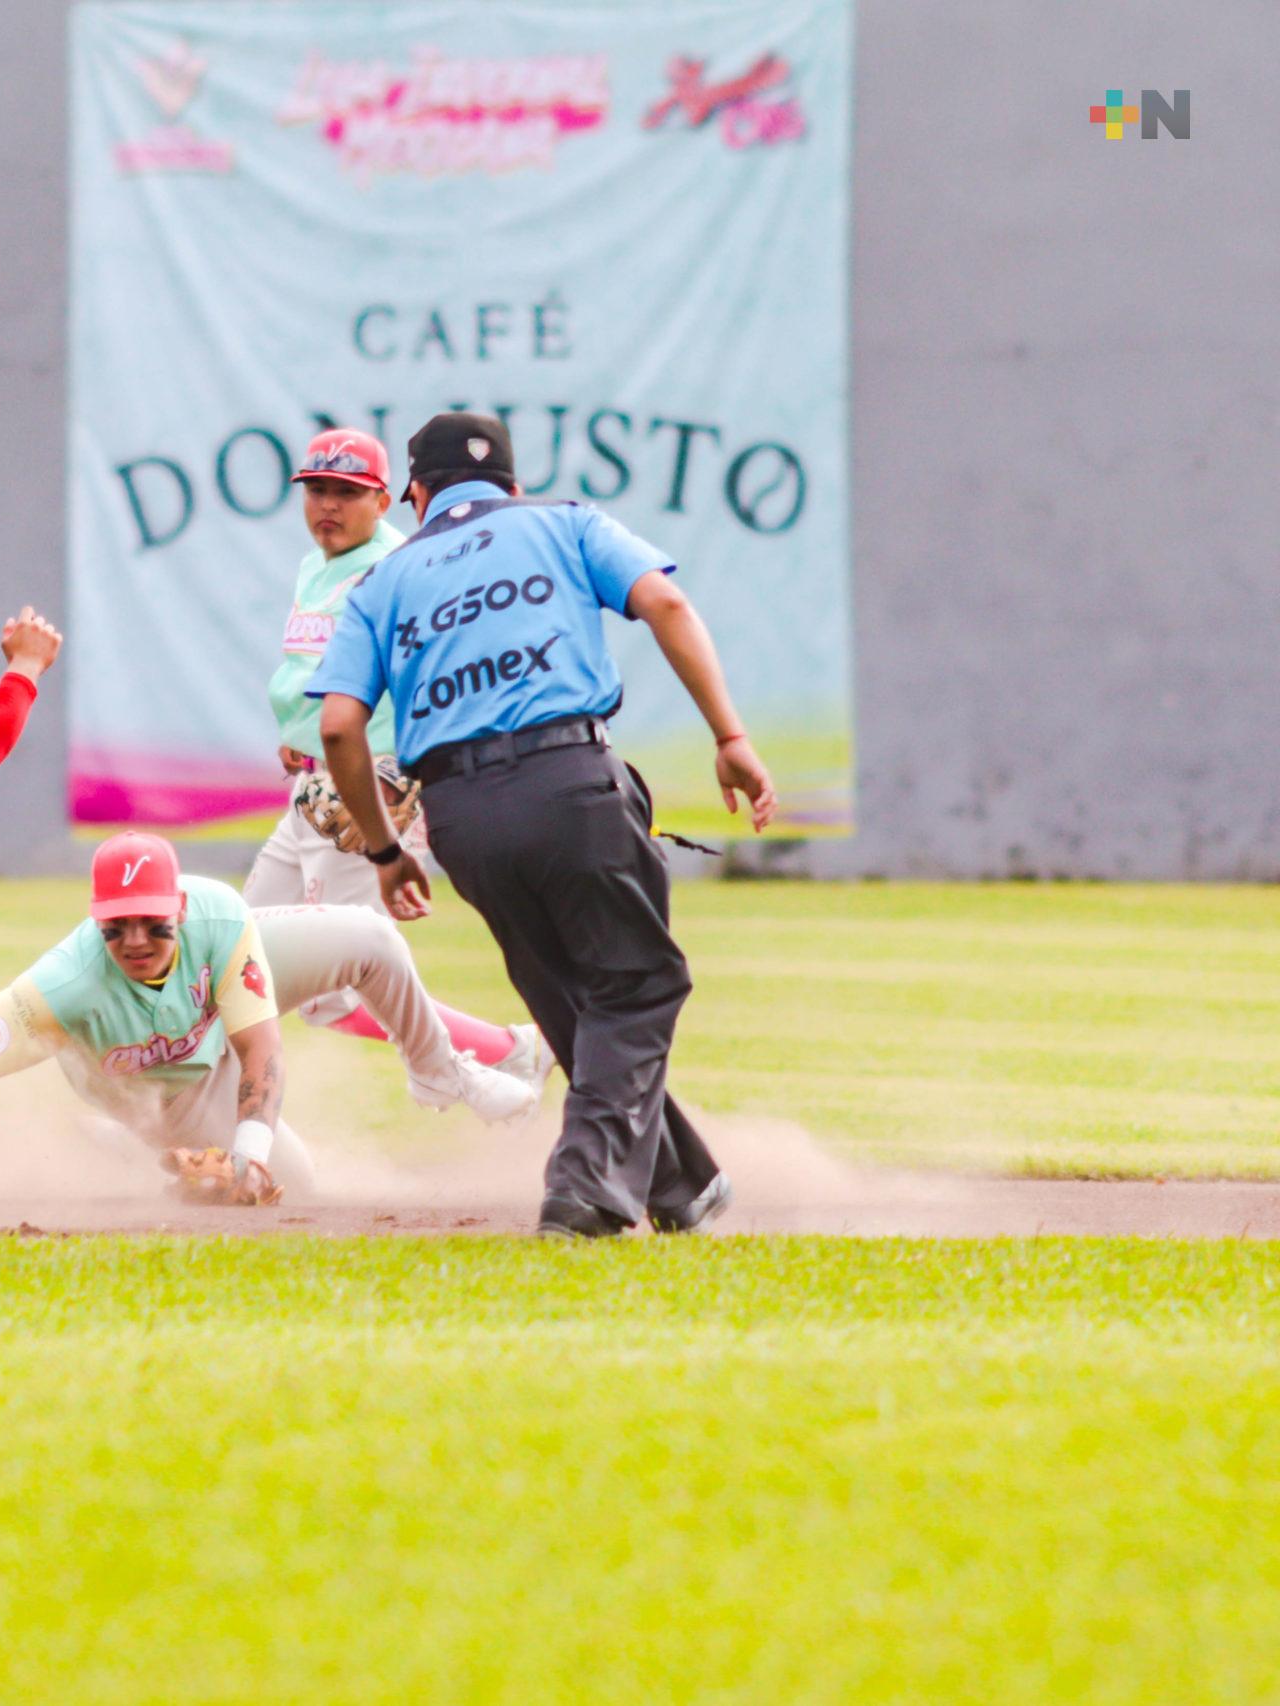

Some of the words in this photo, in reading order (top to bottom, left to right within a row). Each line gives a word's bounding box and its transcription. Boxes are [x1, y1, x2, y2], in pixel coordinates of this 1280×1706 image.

[352, 291, 574, 360] CAFÉ
[114, 407, 390, 549] DO
[448, 403, 807, 535] USTO
[430, 573, 555, 633] G500
